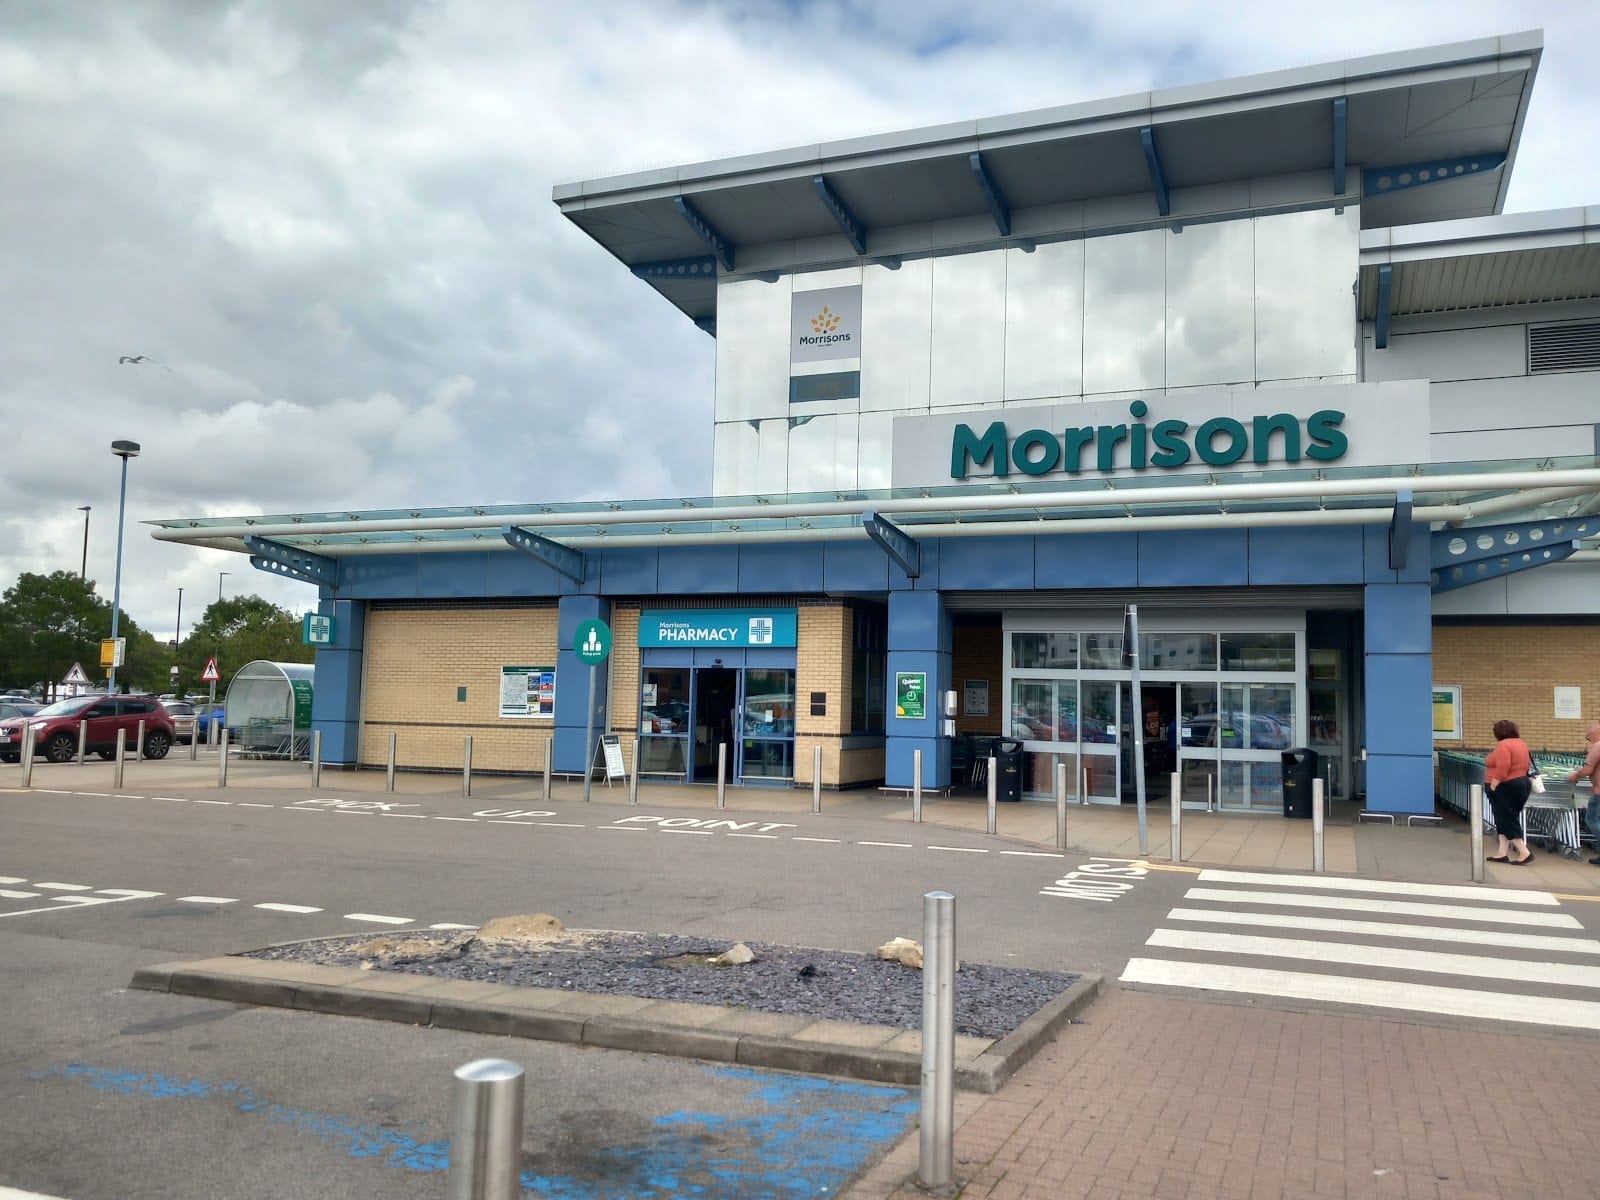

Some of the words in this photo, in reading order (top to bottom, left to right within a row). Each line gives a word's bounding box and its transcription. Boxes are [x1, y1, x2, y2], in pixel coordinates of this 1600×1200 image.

[799, 330, 851, 345] Morrisons
[951, 400, 1348, 479] Morrisons
[659, 628, 738, 641] PHARMACY
[293, 798, 421, 811] PICK
[472, 809, 557, 818] UP
[613, 815, 798, 832] POINT
[1039, 863, 1149, 902] SLOW
